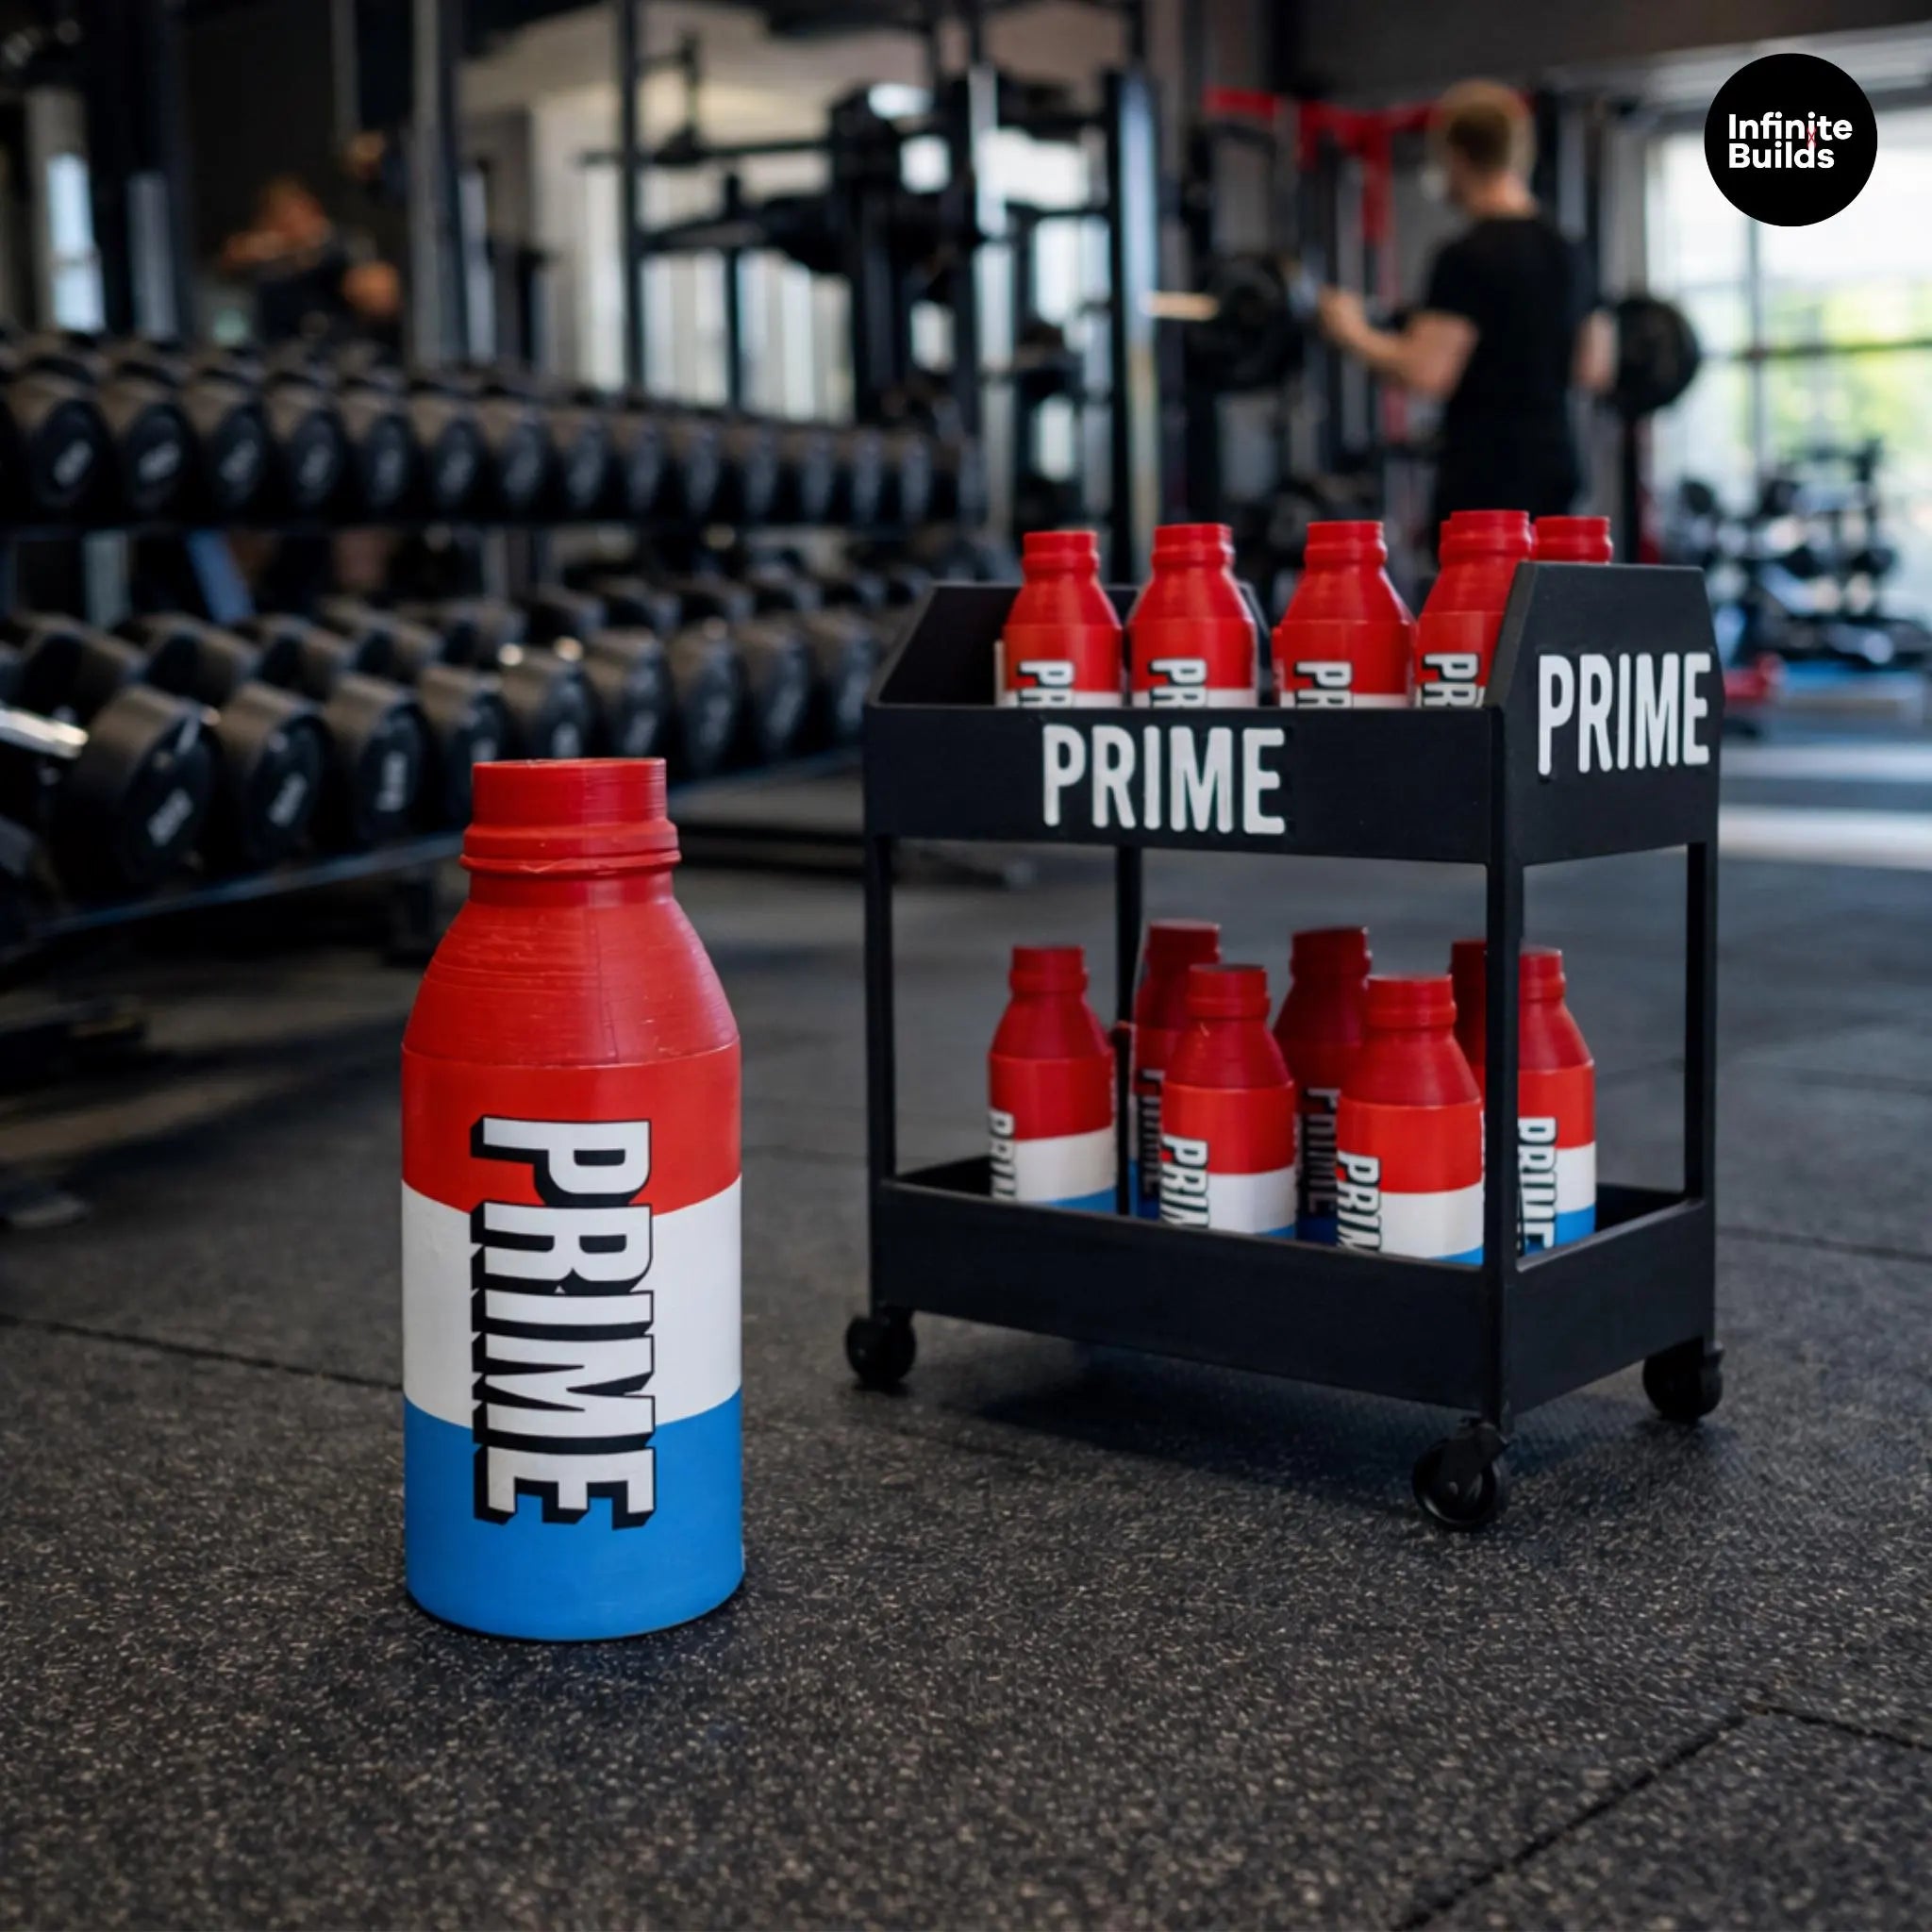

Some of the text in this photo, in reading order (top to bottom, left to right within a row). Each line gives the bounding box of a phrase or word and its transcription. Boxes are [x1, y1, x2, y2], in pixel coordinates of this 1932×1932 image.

[1538, 653, 1711, 776] PRIME
[1042, 724, 1285, 835] PRIME
[470, 1115, 656, 1530] PRIME
